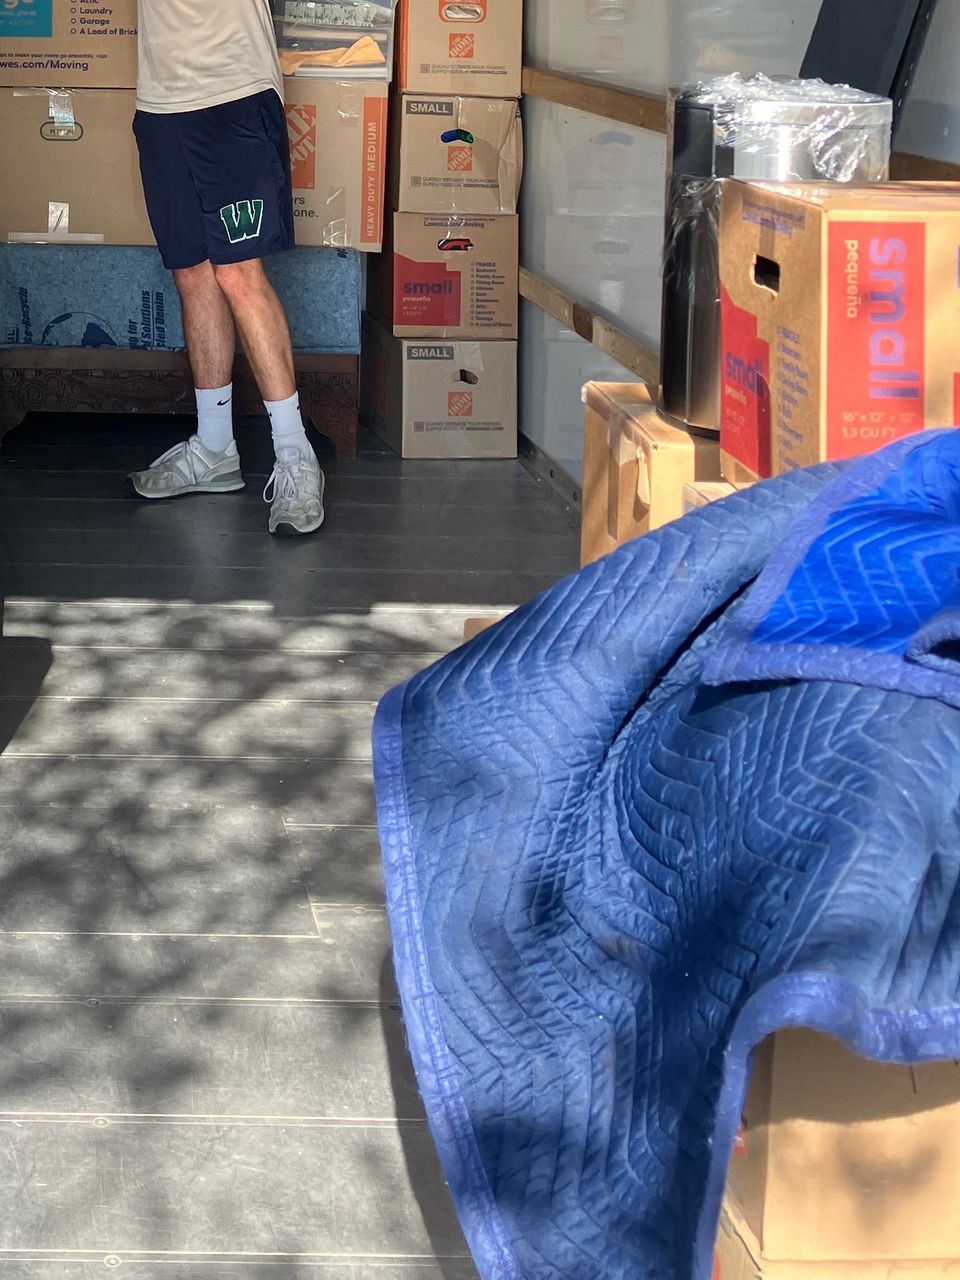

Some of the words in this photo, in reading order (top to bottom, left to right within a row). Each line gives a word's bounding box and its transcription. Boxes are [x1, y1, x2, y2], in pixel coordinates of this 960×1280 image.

[80, 7, 113, 16] Laundry
[80, 17, 110, 26] Garage
[88, 28, 108, 36] Load
[110, 28, 118, 36] of
[410, 103, 449, 113] SMALL
[367, 122, 377, 171] MEDIUM
[367, 176, 375, 203] DUTY
[220, 199, 264, 244] W
[293, 208, 319, 218] one.
[366, 204, 374, 237] HEAVY
[403, 280, 452, 294] small
[844, 239, 862, 318] pequeña
[141, 290, 152, 339] Solutions
[155, 292, 165, 325] Denim
[868, 237, 920, 399] small
[411, 348, 450, 358] SMALL
[726, 352, 767, 398] small
[843, 412, 859, 422] 16"
[843, 427, 858, 438] 1.3
[860, 427, 880, 438] CU
[883, 427, 897, 438] FT
